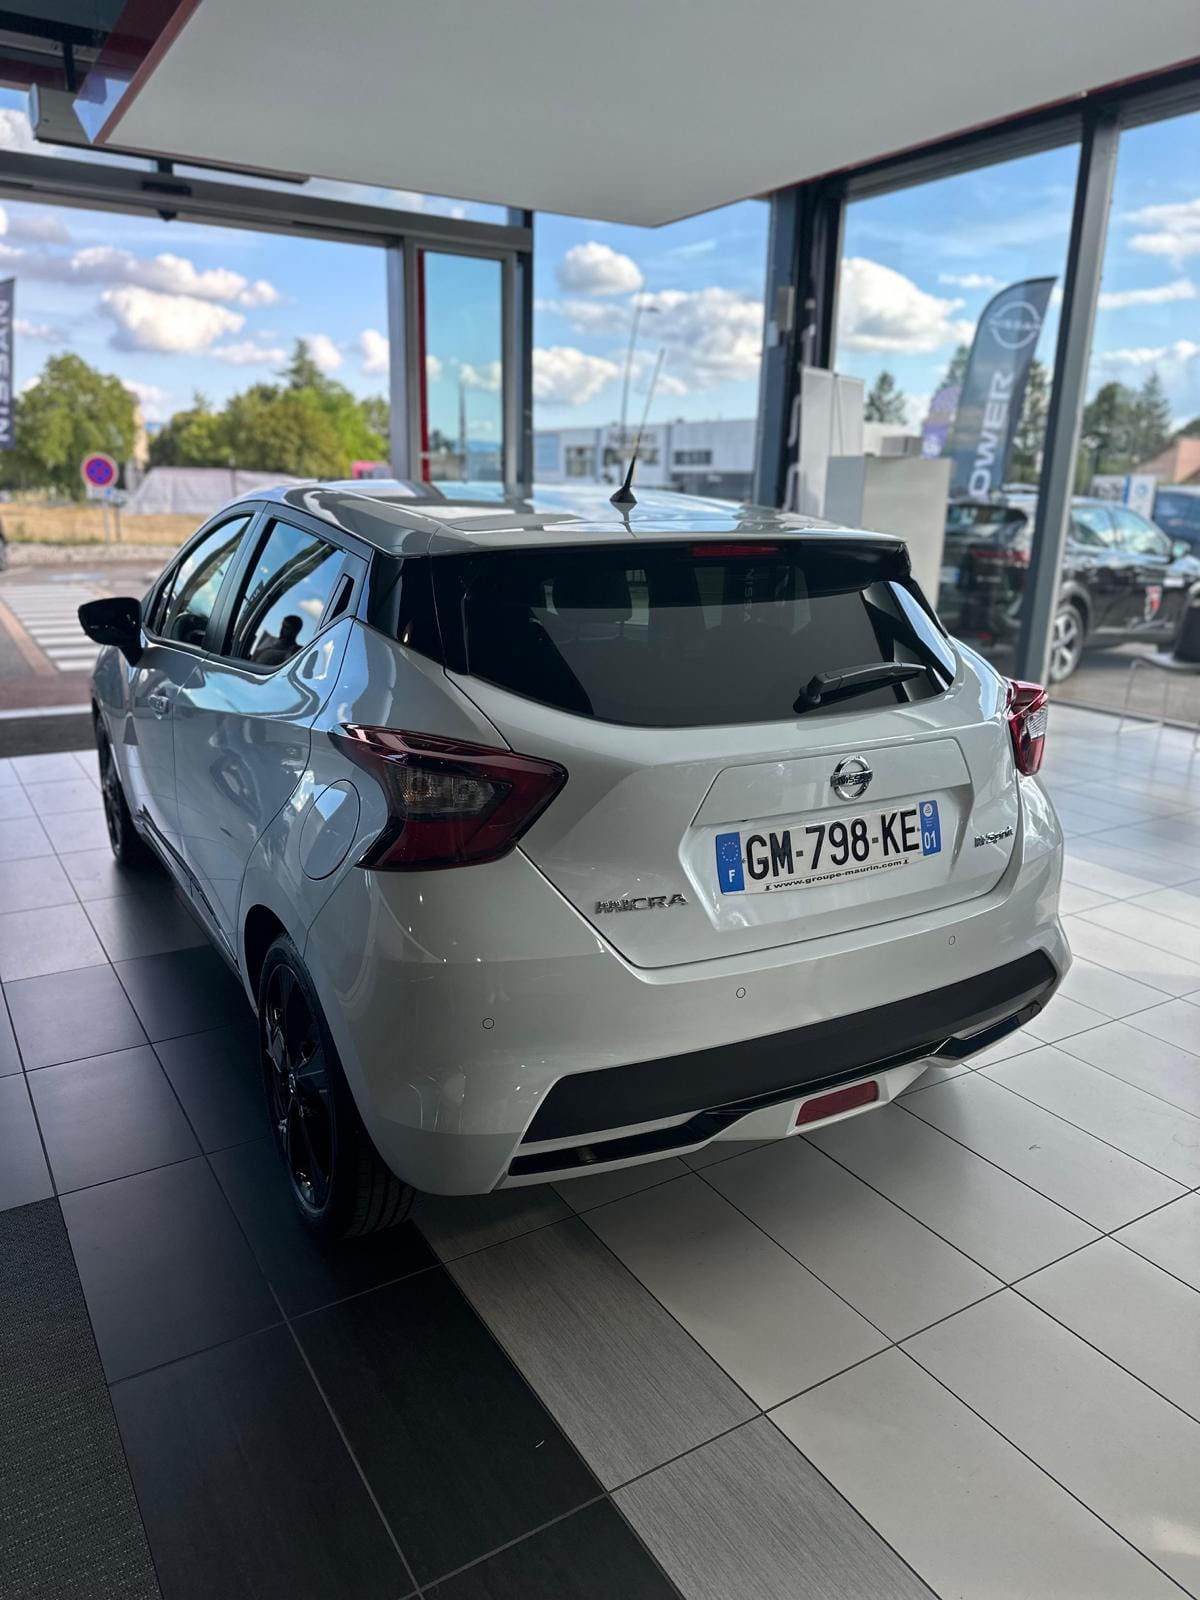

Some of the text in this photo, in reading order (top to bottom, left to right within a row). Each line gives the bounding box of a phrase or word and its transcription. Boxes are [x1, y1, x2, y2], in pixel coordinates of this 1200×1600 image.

[746, 809, 920, 880] GM-798-KE
[924, 830, 937, 850] 01
[728, 869, 736, 883] F
[773, 860, 902, 889] www.groupe-maurin.com
[595, 893, 688, 914] MICRA
